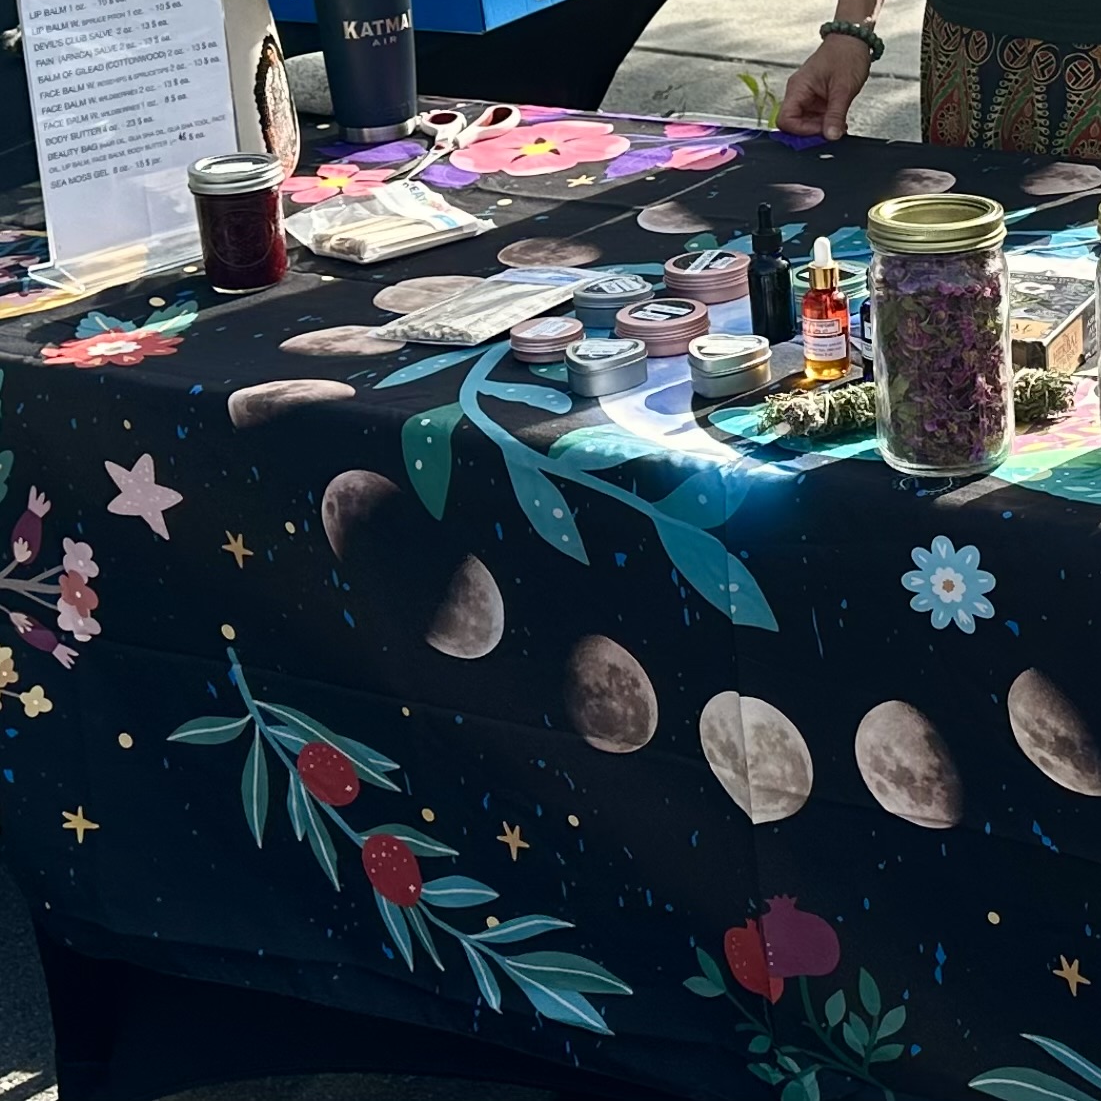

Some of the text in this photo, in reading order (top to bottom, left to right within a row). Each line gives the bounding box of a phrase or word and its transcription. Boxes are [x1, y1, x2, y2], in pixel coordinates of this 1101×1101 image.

[43, 5, 66, 17] BALM
[45, 22, 69, 33] BALM
[372, 35, 398, 47] AIR
[62, 83, 84, 95] BALM
[64, 98, 86, 110] BALM
[45, 135, 68, 146] BODY
[70, 126, 102, 140] BUTTER
[47, 147, 78, 161] BEAUTY
[80, 143, 98, 153] BAG
[51, 179, 67, 189] SEA
[68, 172, 92, 184] MOSS
